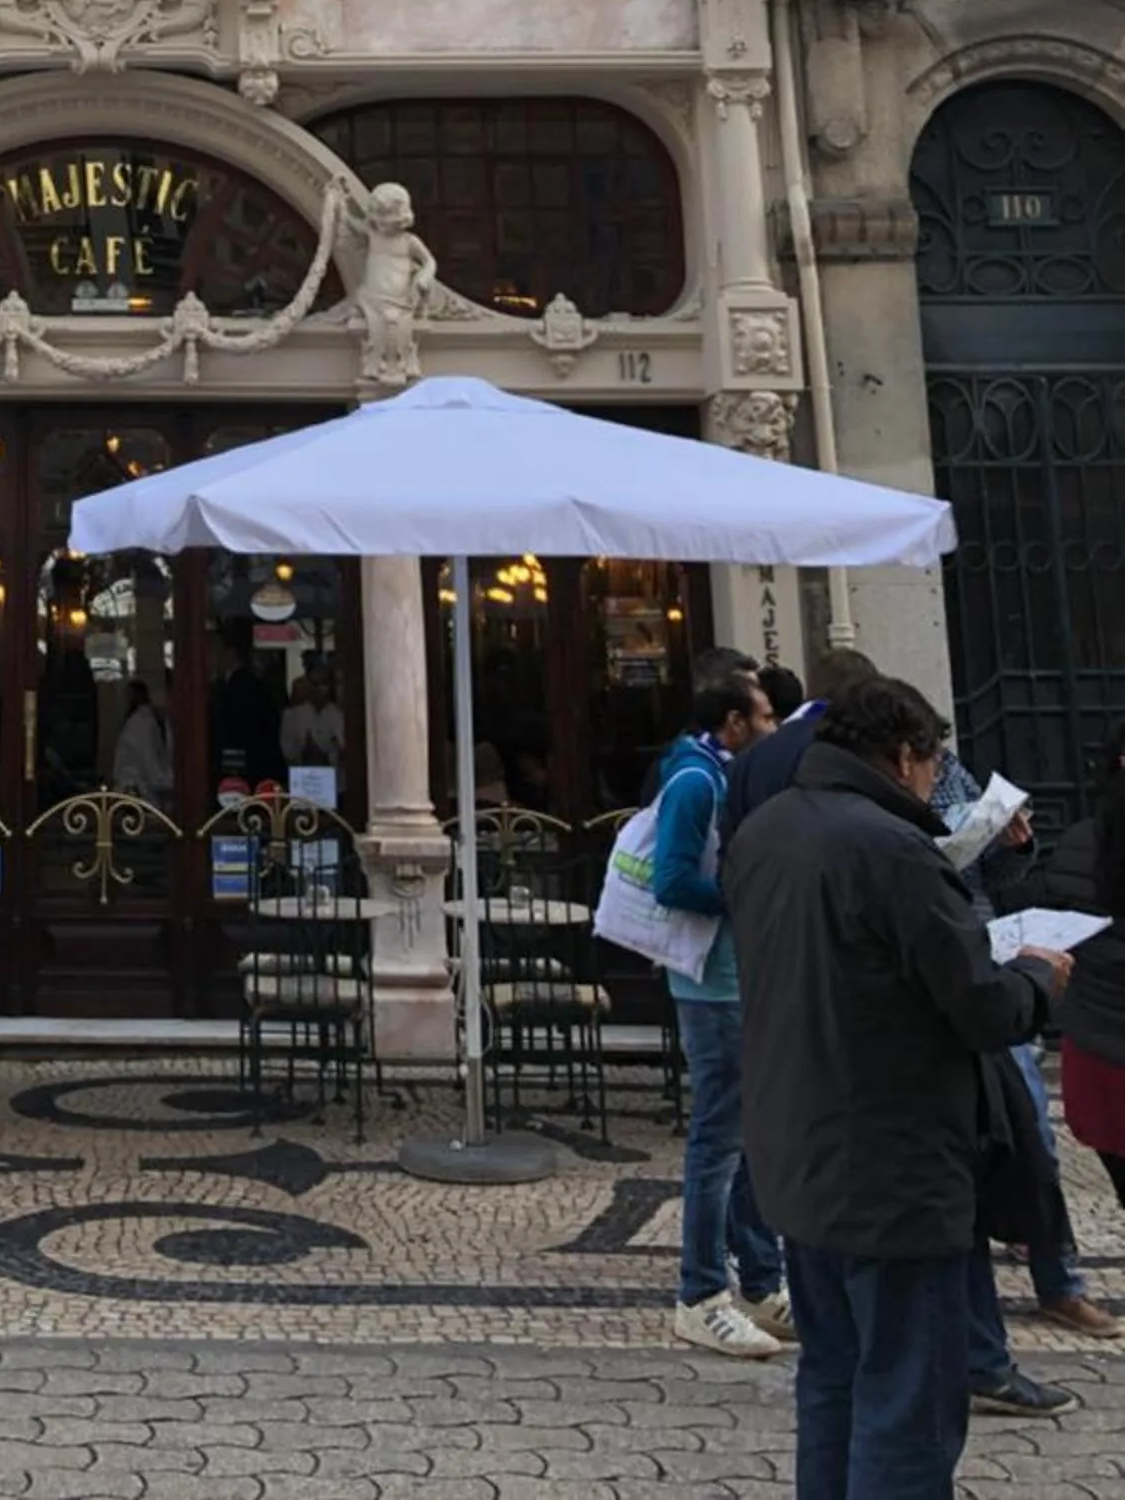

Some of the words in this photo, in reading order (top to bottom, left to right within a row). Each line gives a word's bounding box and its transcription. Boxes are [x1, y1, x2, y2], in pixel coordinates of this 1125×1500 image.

[0, 161, 199, 222] MAJESTIC
[1002, 195, 1041, 220] 110
[50, 225, 154, 275] CAFÉ
[618, 352, 652, 384] 112
